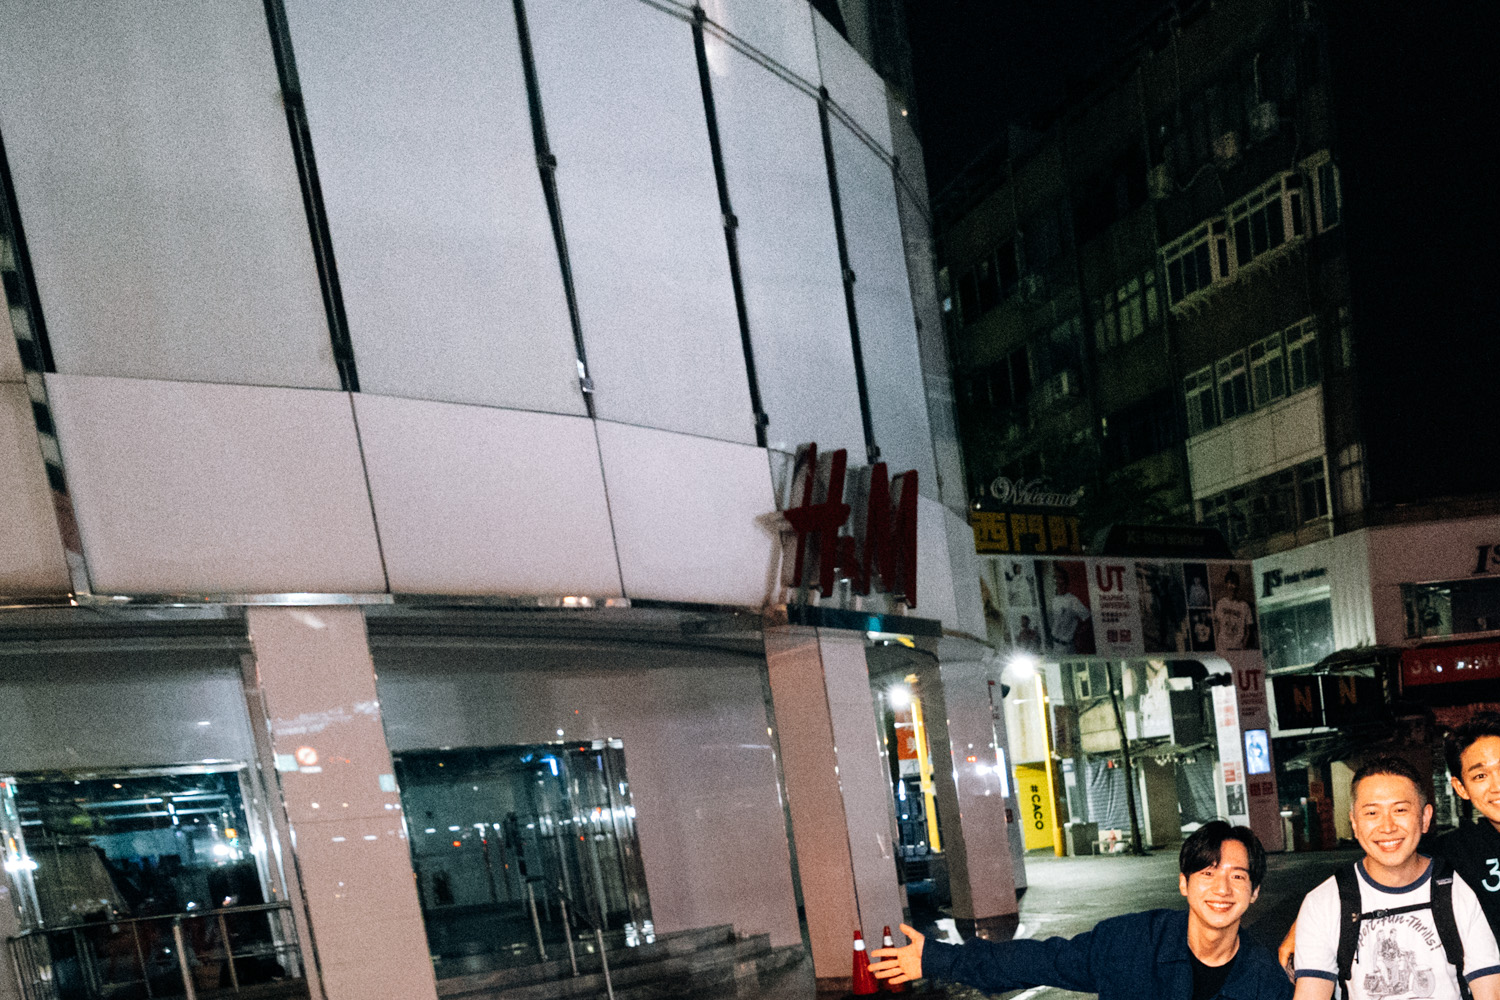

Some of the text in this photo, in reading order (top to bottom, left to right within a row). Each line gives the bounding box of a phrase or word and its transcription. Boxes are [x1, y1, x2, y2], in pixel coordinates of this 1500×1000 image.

[783, 441, 918, 609] H&M
[970, 511, 1081, 554] 西門町
[1096, 564, 1126, 592] UT
[1237, 668, 1261, 692] UT
[1031, 784, 1045, 831] #CACO
